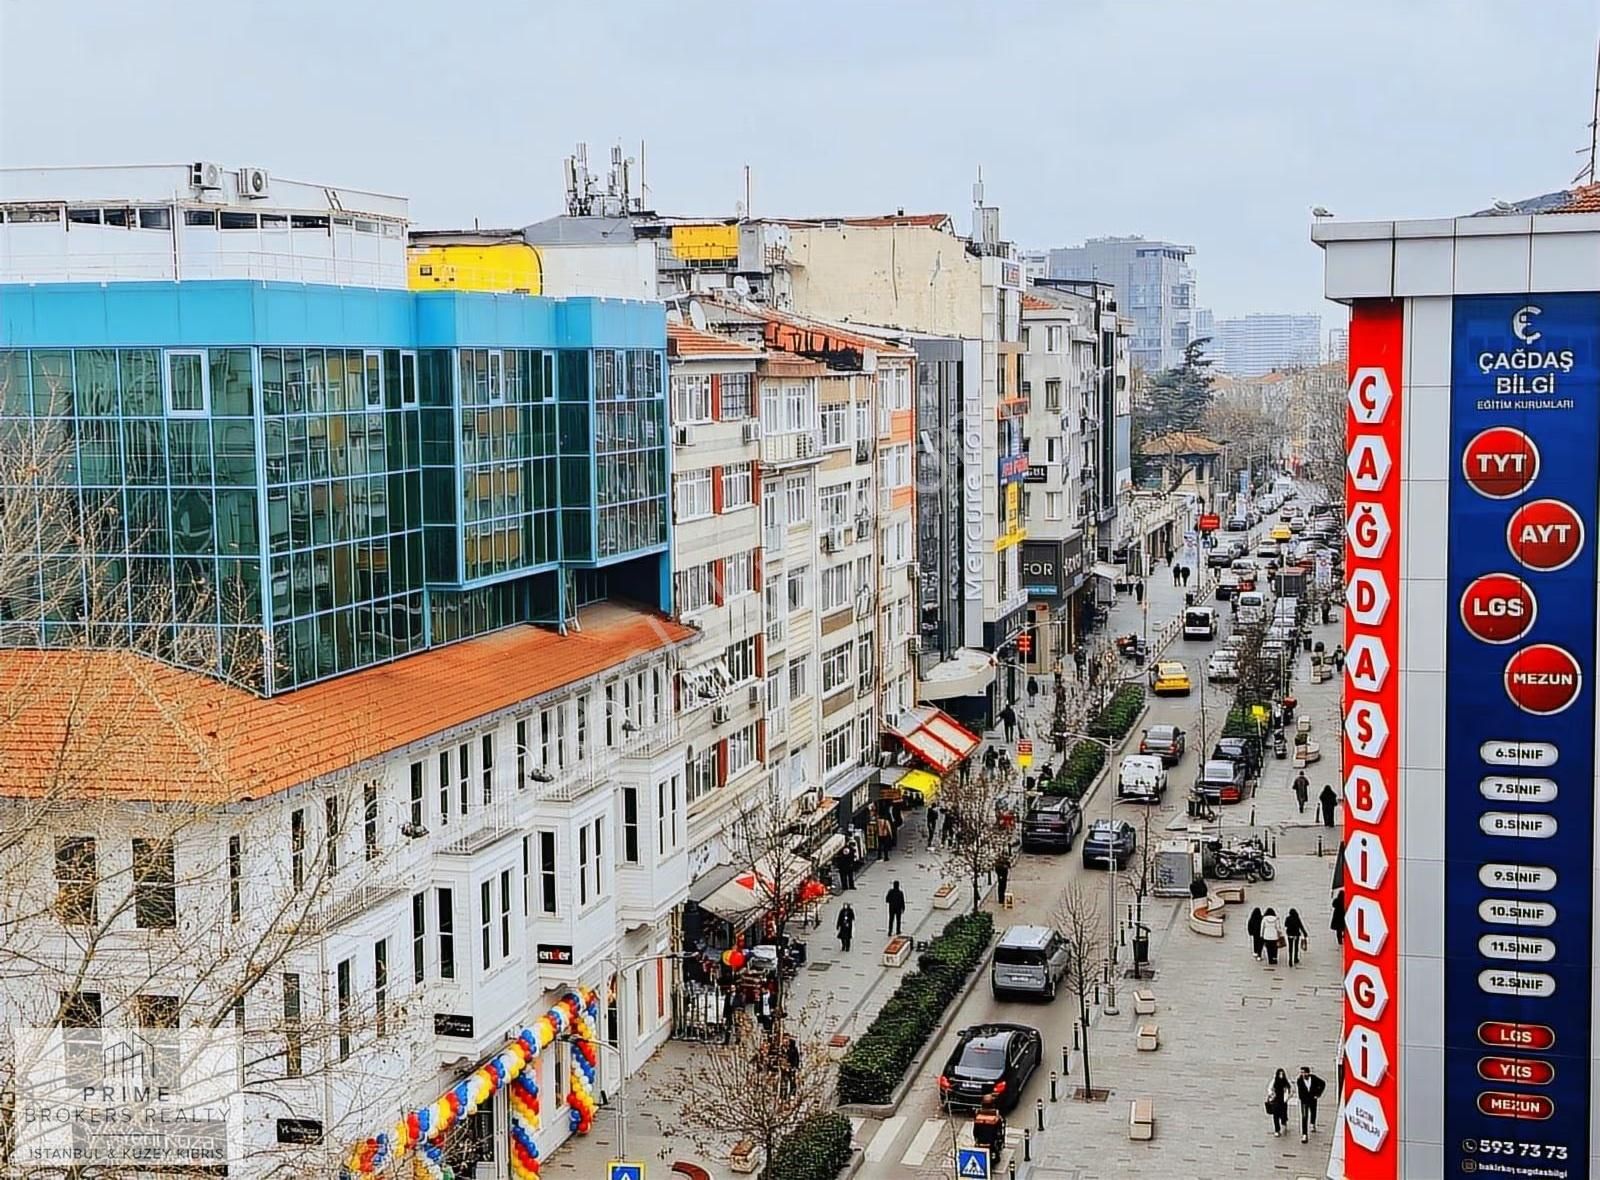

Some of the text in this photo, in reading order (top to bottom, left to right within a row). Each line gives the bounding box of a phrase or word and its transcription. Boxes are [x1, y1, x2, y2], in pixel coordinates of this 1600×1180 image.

[1478, 349, 1574, 373] ÇAĞDAŞ
[1496, 373, 1555, 395] BİLGİ
[1477, 398, 1574, 410] EĞİTİM KURUMLARI
[1476, 453, 1528, 473] TYT
[1519, 524, 1572, 543] AYT
[1355, 375, 1378, 750] ÇAĞDAŞ
[1473, 597, 1524, 617] LGS
[1513, 673, 1573, 686] MEZUN
[1495, 747, 1543, 760] 6.SINIF
[1494, 783, 1542, 796] 7.SINIF
[1494, 819, 1543, 832] 8.SINIF
[1494, 870, 1541, 884] 9.SINIF
[1489, 905, 1545, 920] 10.SINIF
[1490, 941, 1543, 955] 11.SINIF
[1489, 976, 1544, 990] 12.SINIF
[1500, 1029, 1533, 1044] LGS
[1499, 1064, 1533, 1079] YKS
[1491, 1099, 1541, 1113] MEZUN
[1478, 1139, 1569, 1160] 593 73 73
